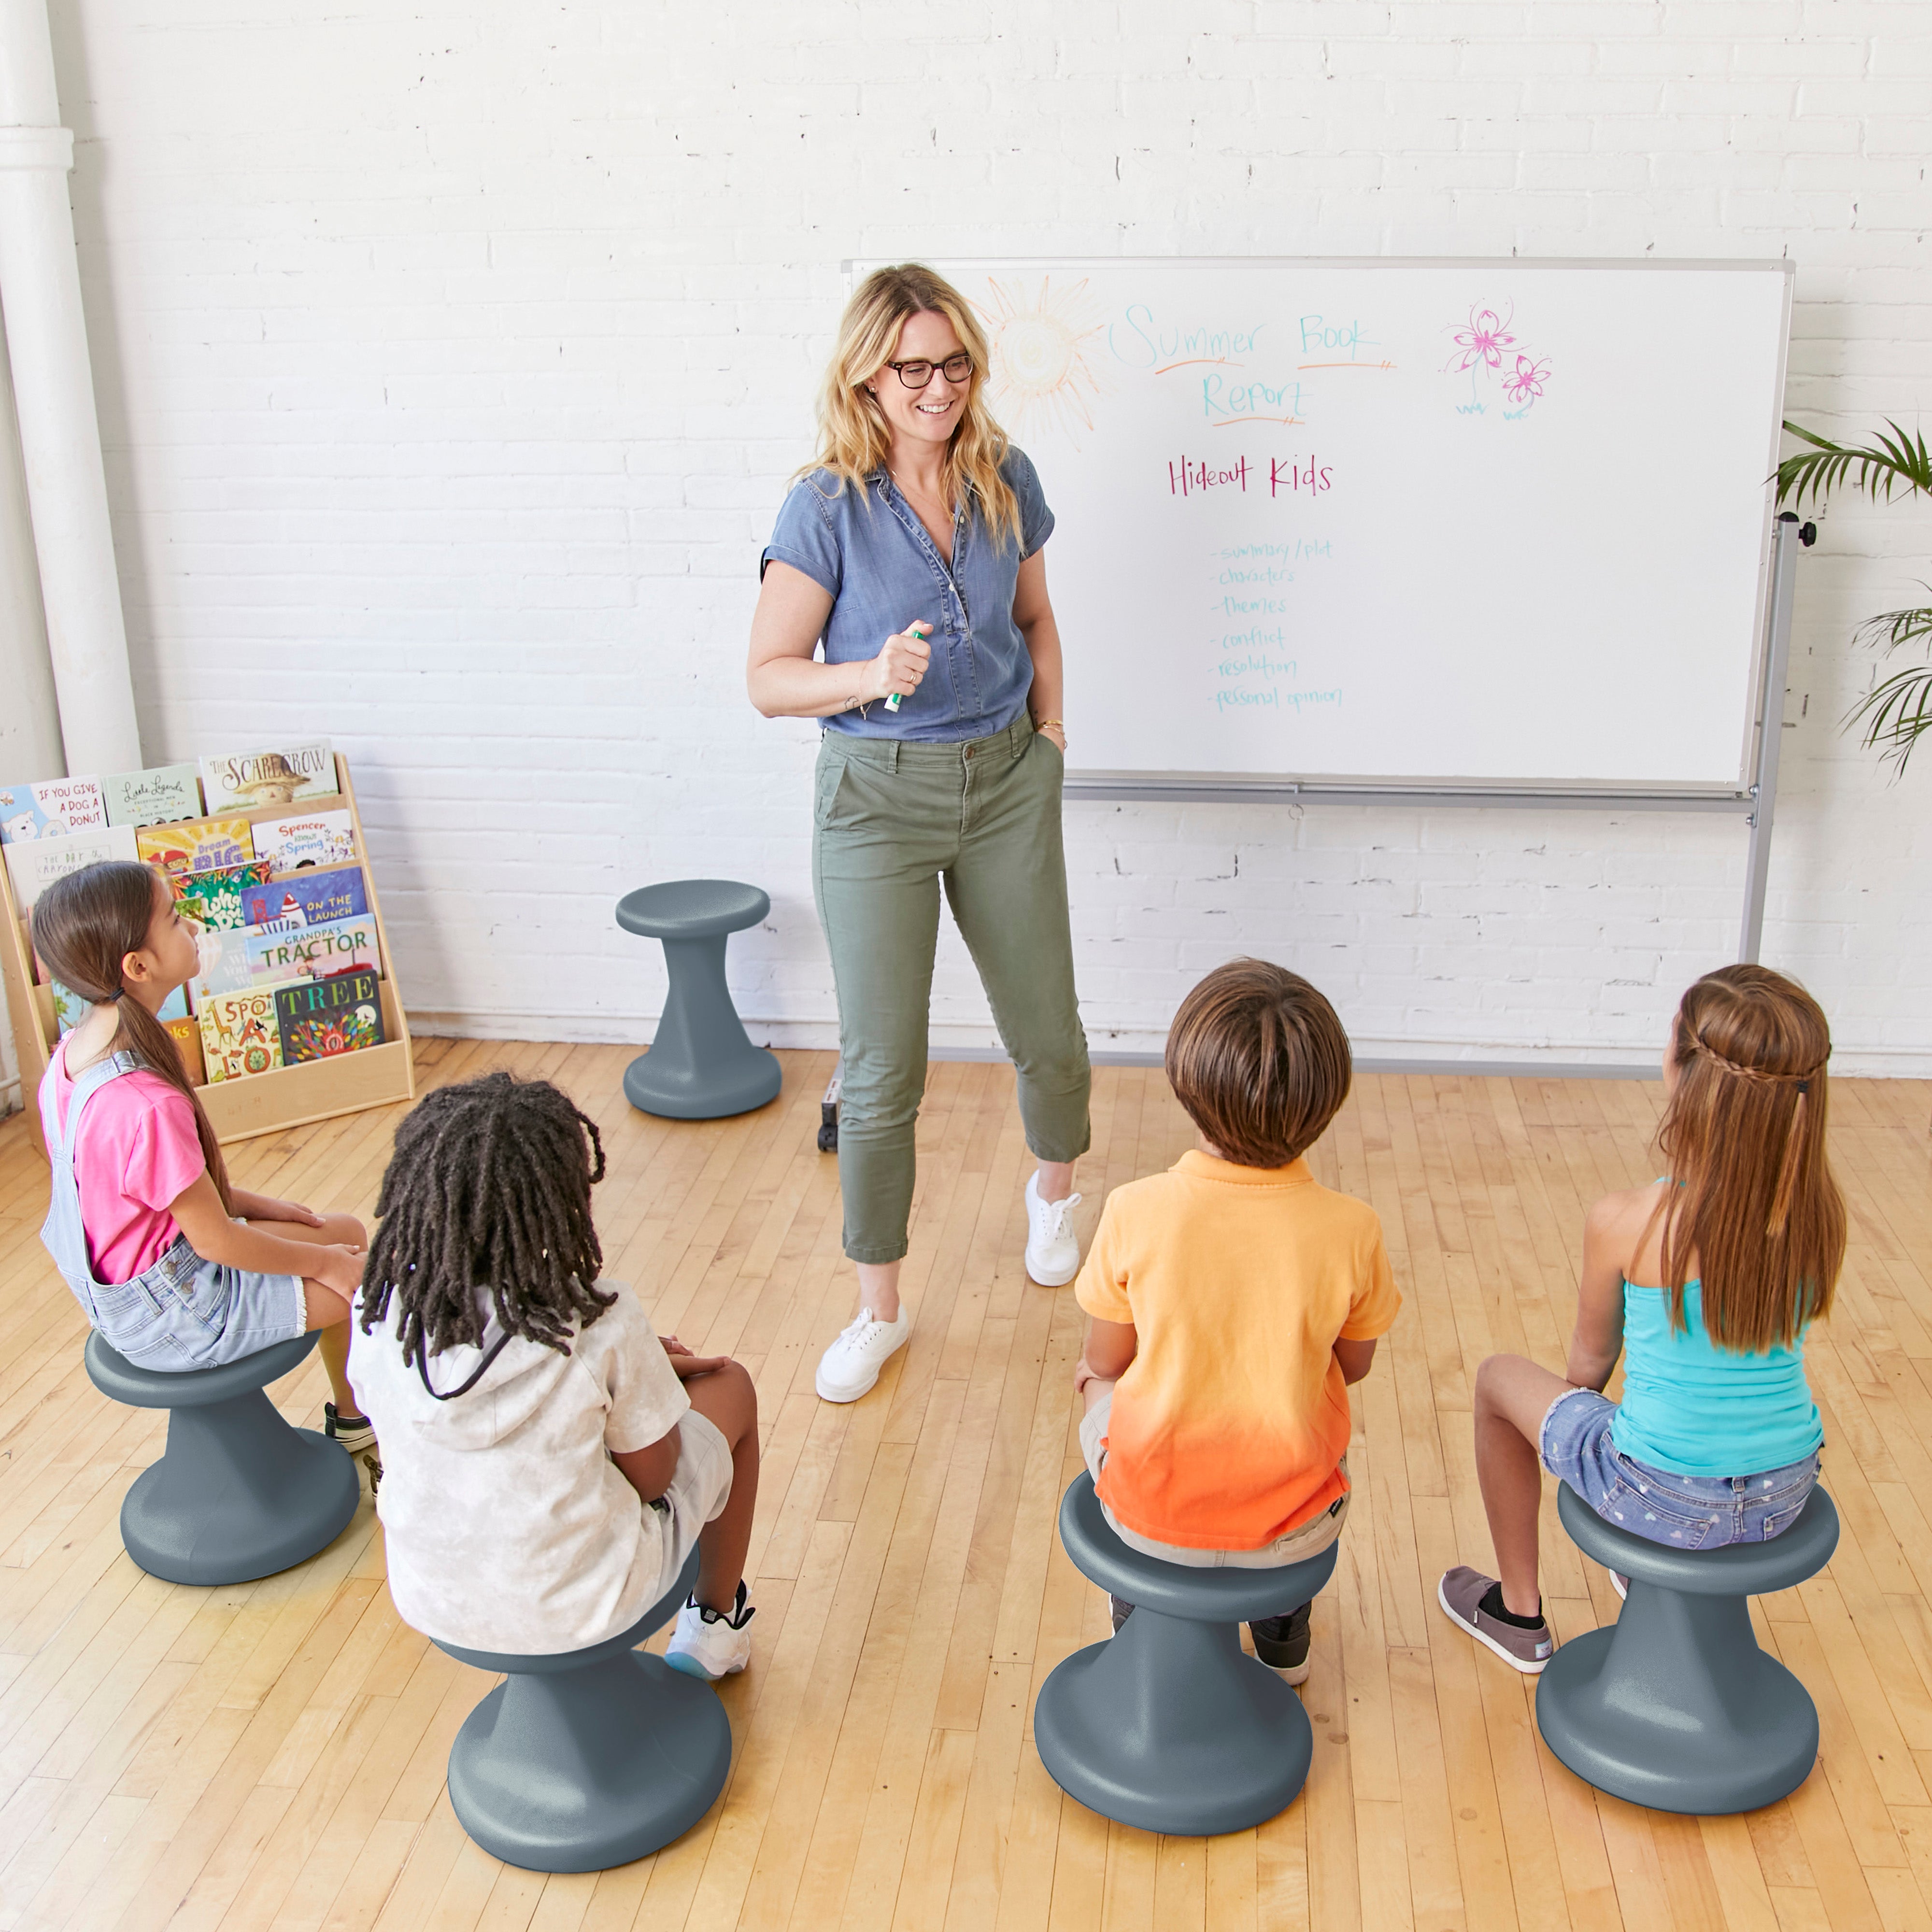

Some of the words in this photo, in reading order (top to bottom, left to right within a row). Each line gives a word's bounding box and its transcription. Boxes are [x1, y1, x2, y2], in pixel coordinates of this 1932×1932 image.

[1109, 304, 1267, 368] Summer
[1300, 315, 1381, 360] Book
[1203, 373, 1314, 416] Report
[1169, 455, 1253, 496] Hideout
[1270, 455, 1333, 497] Kids
[1287, 688, 1342, 714] opinion
[210, 760, 227, 774] THE
[222, 748, 326, 791] SCARECROW
[39, 789, 49, 800] IF
[52, 787, 71, 798] YOU
[73, 783, 97, 794] GIVE
[122, 781, 150, 803] Little
[151, 775, 185, 796] Legends
[60, 803, 66, 813] A
[69, 799, 90, 810] DOG
[93, 798, 99, 808] A
[70, 811, 100, 826] DONUT
[279, 823, 326, 837] Spencer
[194, 845, 244, 870] BIG
[199, 838, 230, 854] Dream
[285, 839, 324, 855] Spring
[307, 901, 323, 911] ON
[328, 895, 351, 907] THE
[309, 907, 352, 923] LAUNCH
[285, 926, 341, 944] GRANDPA'S
[261, 931, 367, 967] TRACTOR
[282, 976, 374, 1015] TREE
[226, 1000, 266, 1022] SPO
[239, 1018, 266, 1046] A
